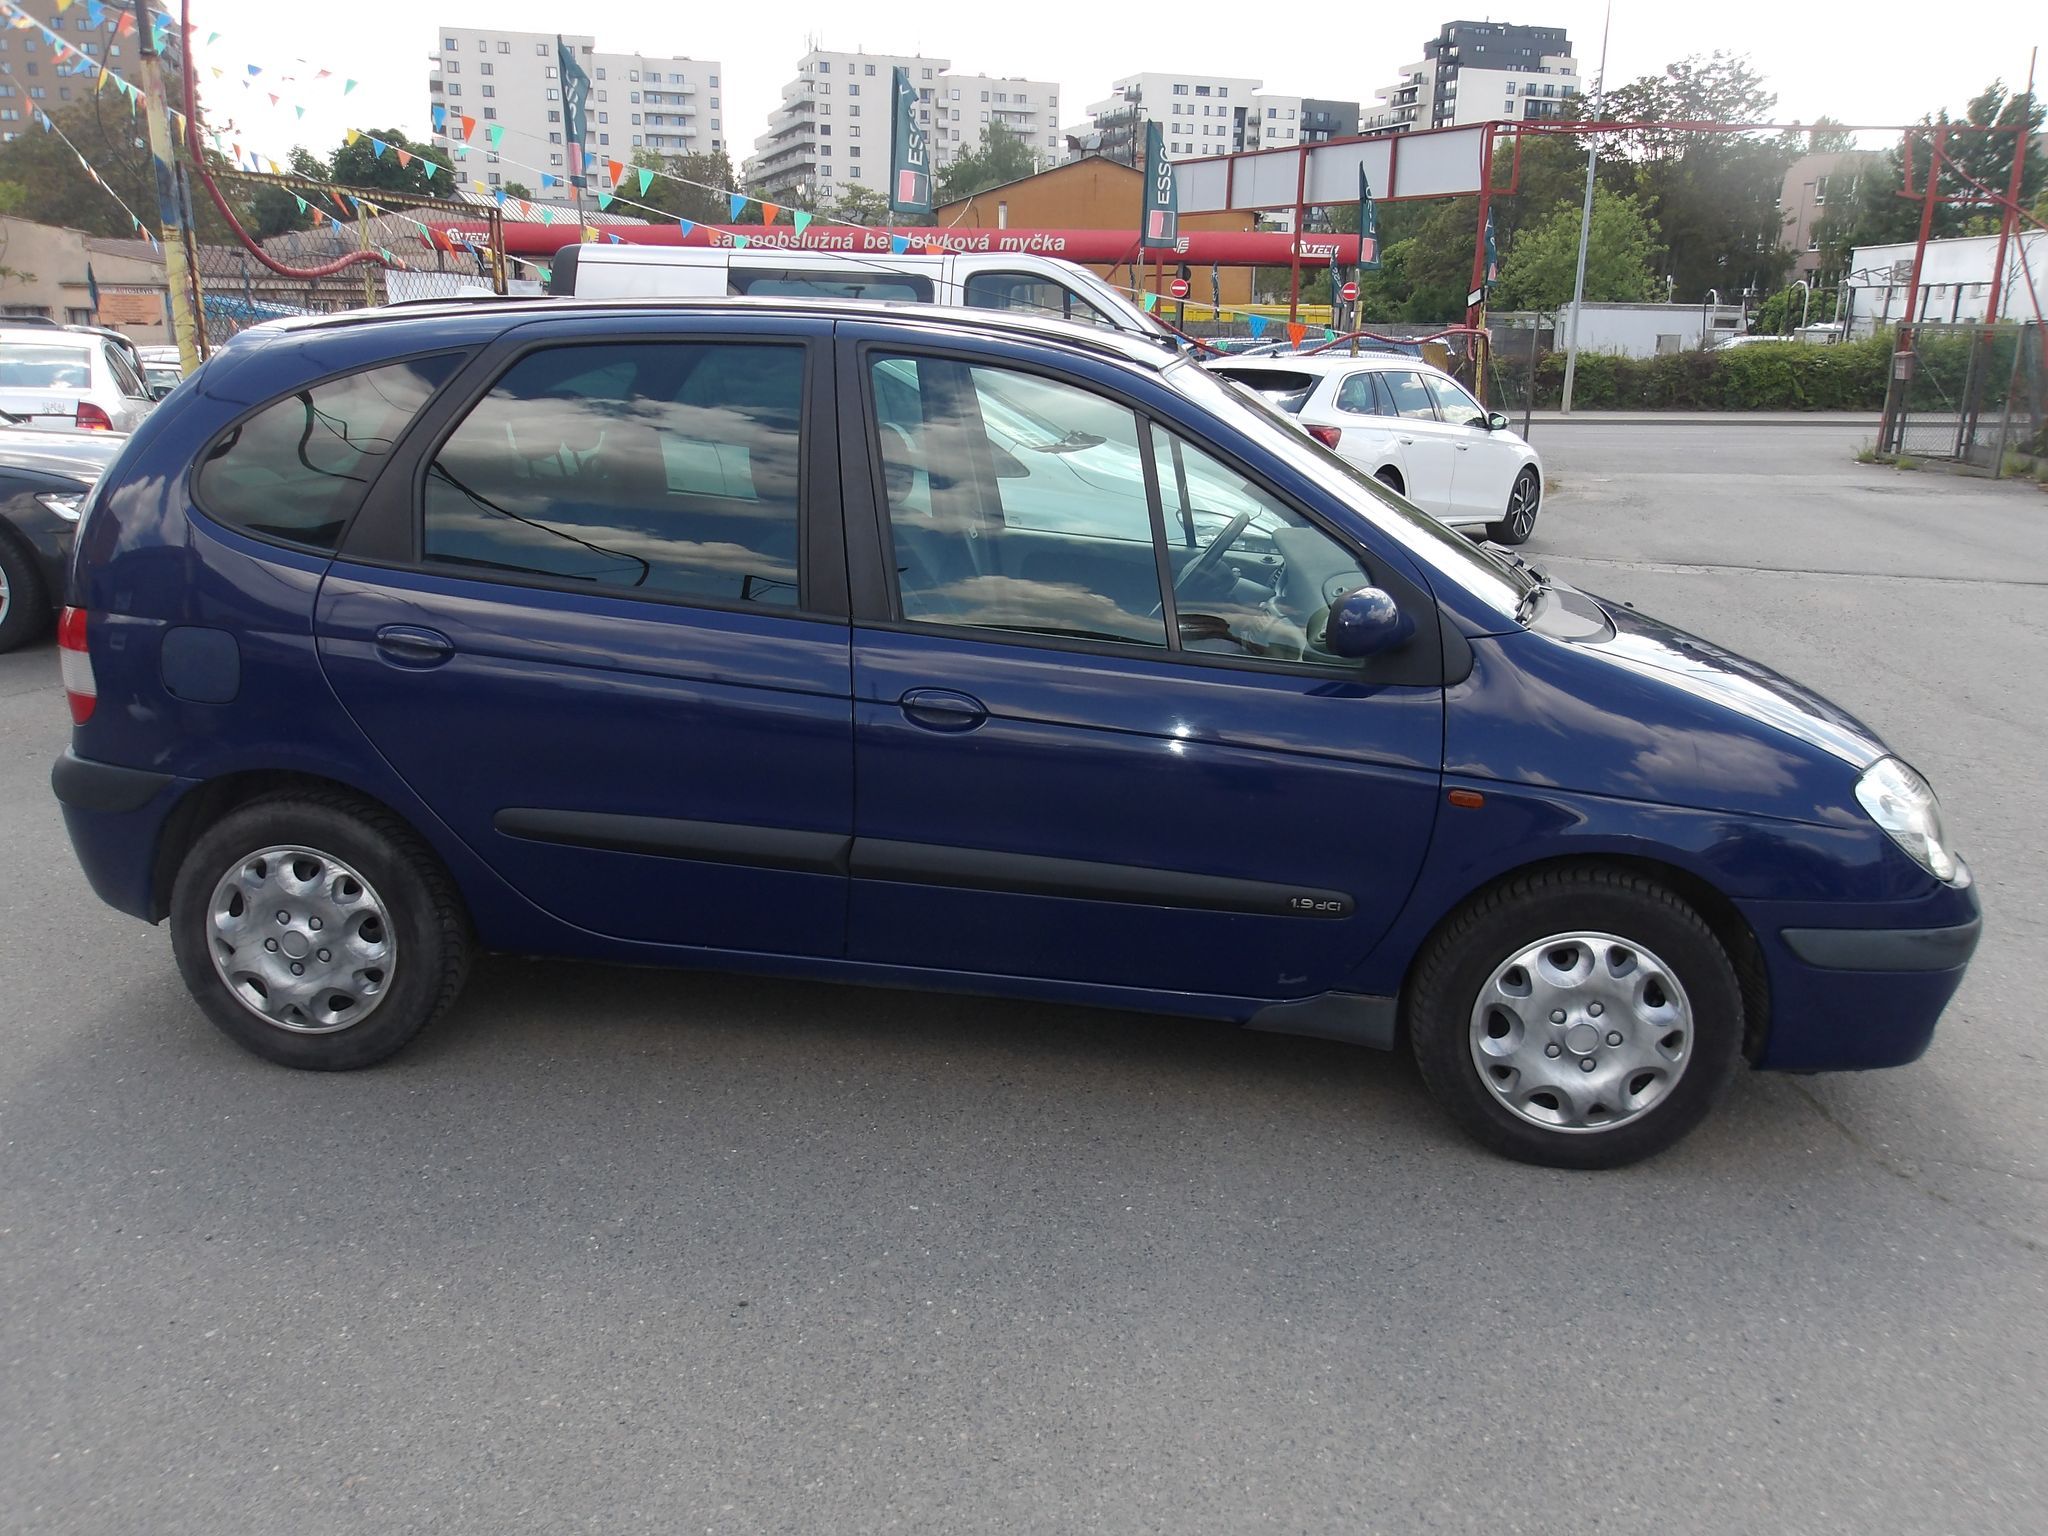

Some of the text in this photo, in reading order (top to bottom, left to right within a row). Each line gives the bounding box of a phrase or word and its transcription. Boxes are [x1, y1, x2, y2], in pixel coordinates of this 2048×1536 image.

[863, 232, 991, 251] beotyková
[999, 233, 1066, 253] myčka
[1290, 898, 1341, 911] 1.9 dCi
